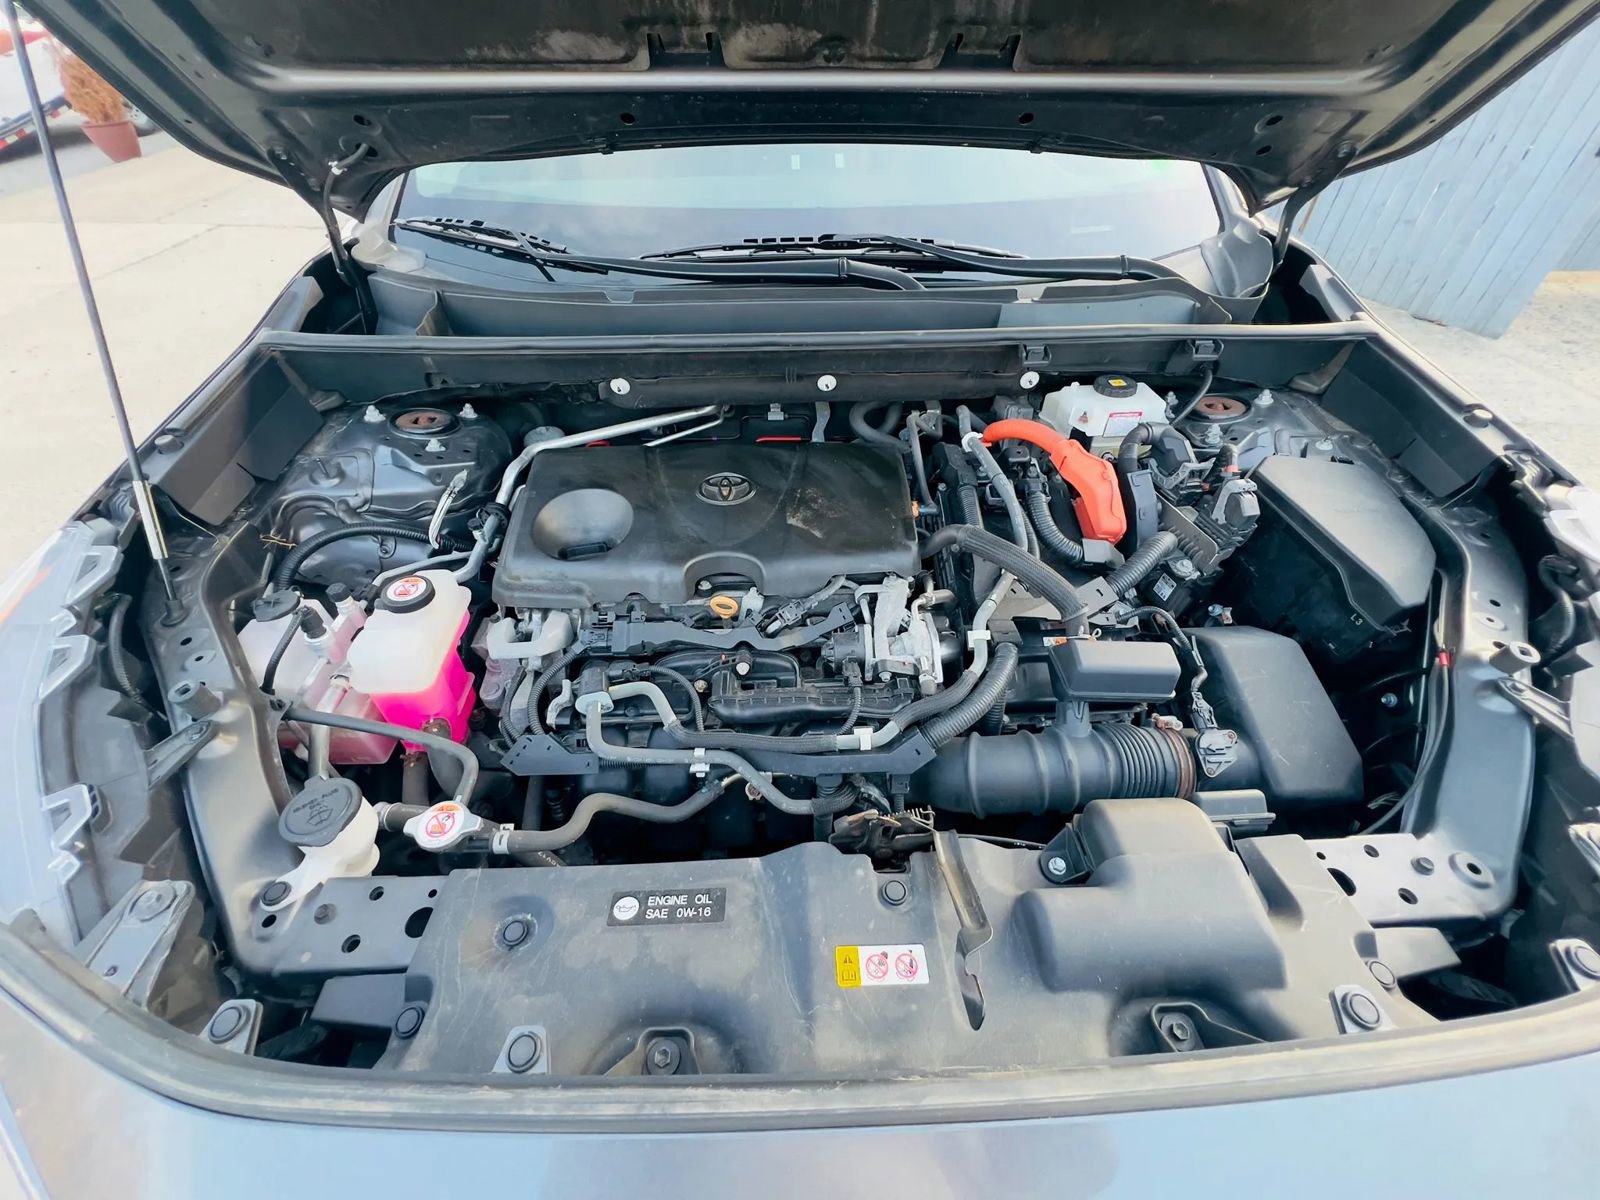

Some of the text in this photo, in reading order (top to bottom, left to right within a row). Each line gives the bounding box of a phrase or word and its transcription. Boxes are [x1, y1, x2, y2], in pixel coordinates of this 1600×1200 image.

[647, 894, 713, 906] ENGINE OIL
[645, 907, 712, 919] SAE 0W-16
